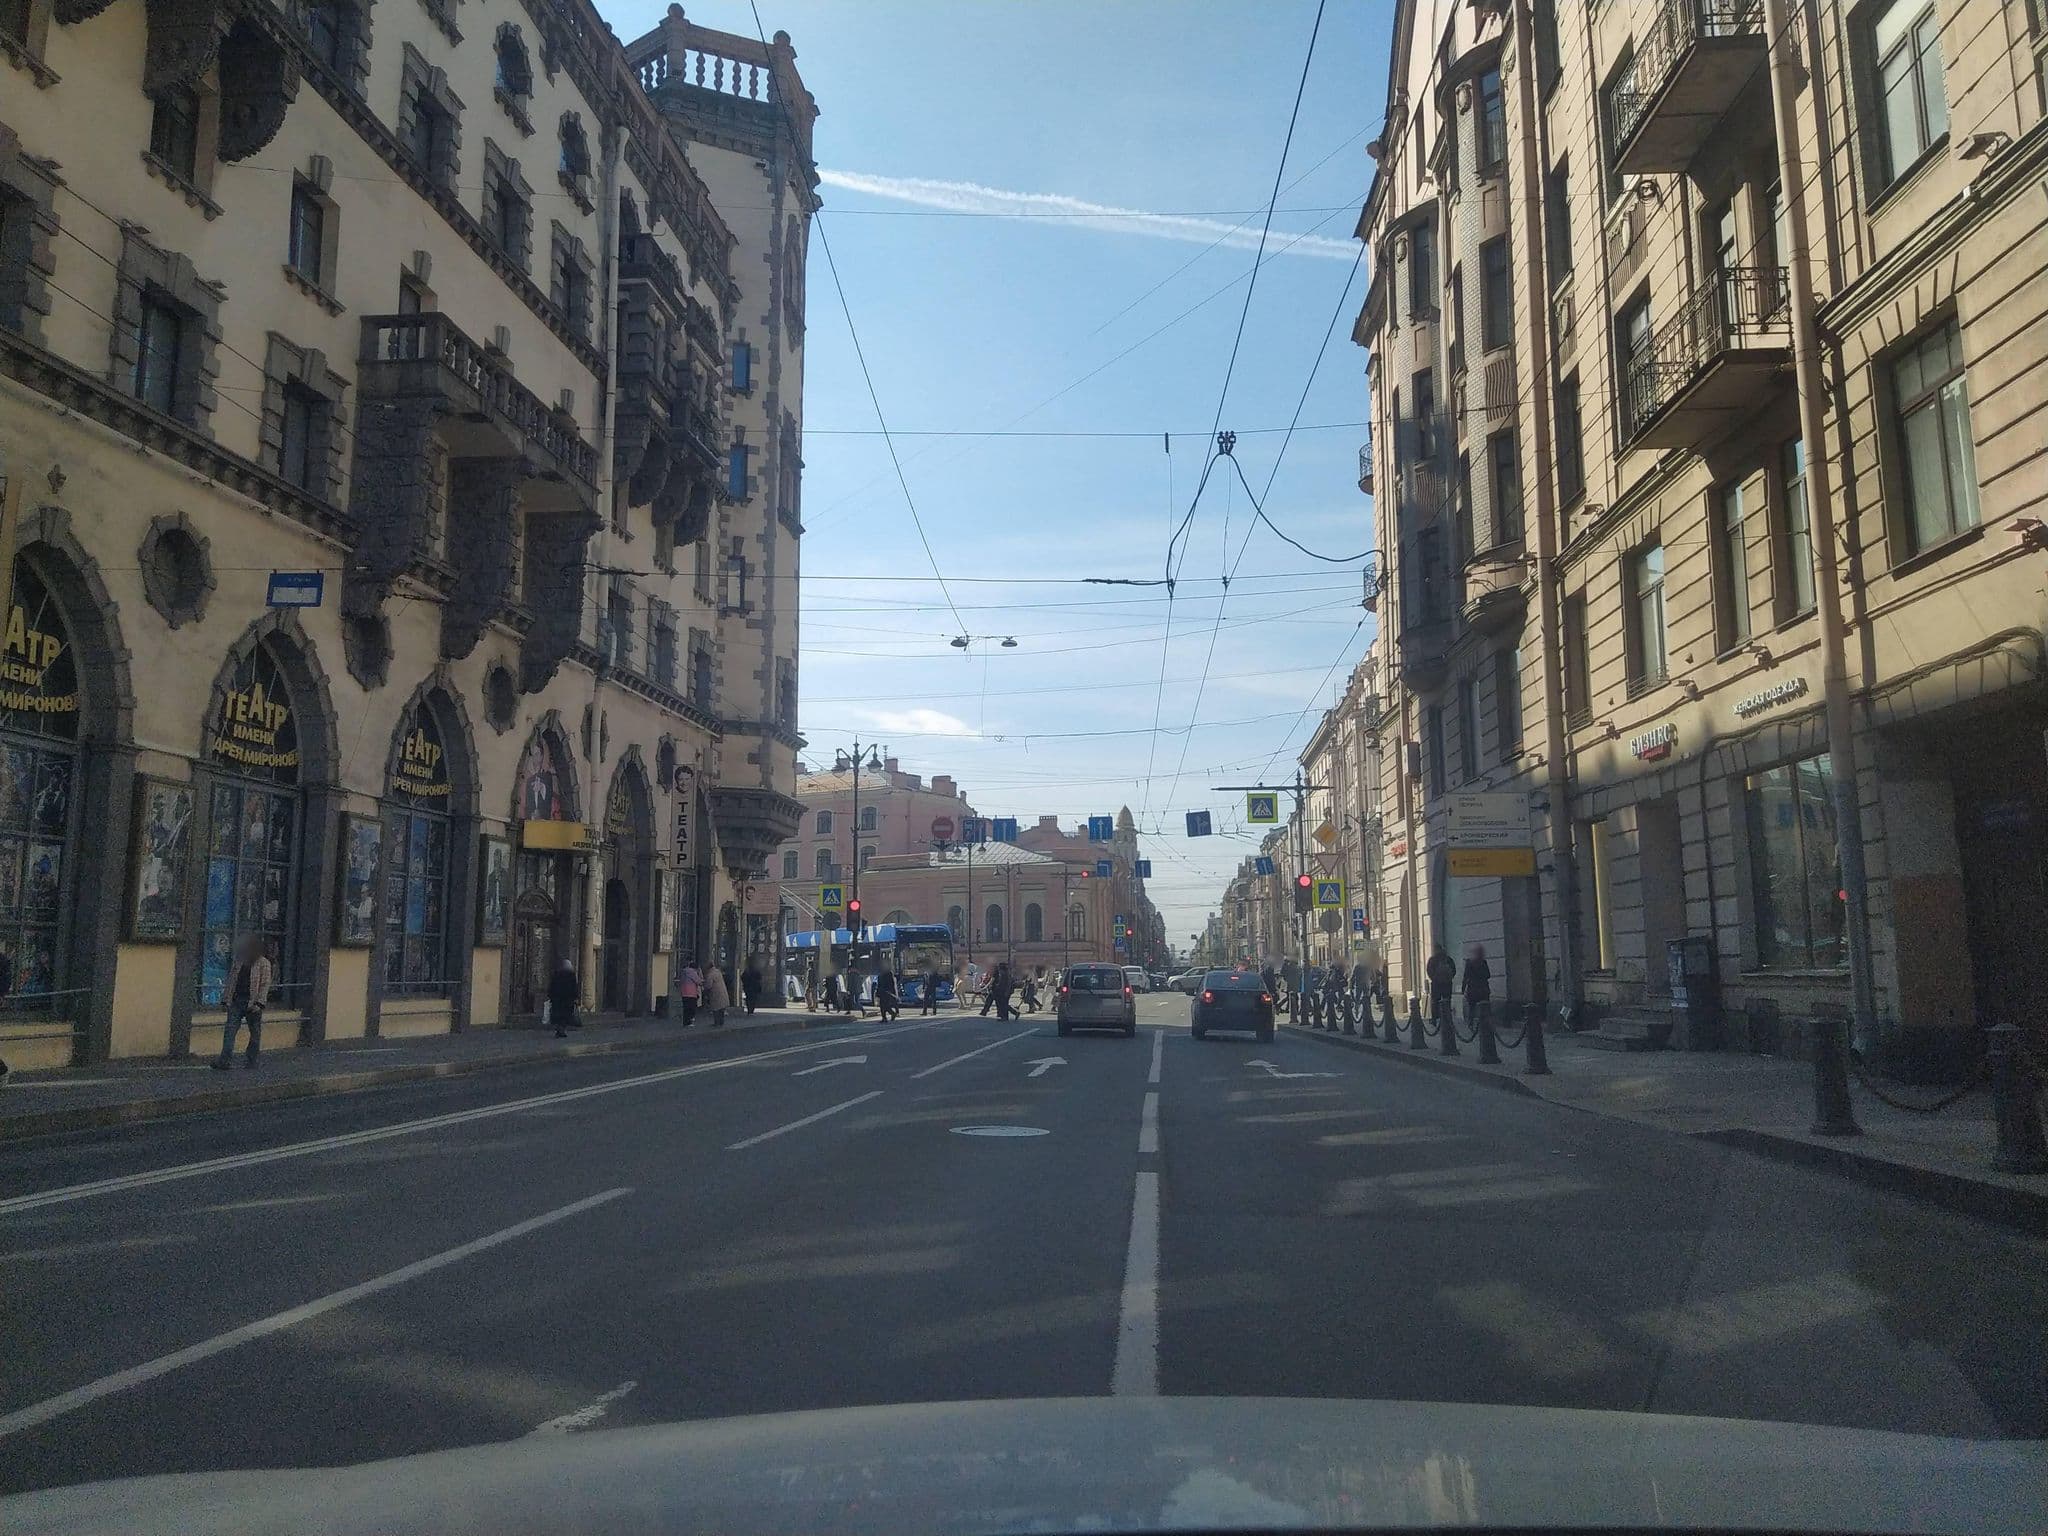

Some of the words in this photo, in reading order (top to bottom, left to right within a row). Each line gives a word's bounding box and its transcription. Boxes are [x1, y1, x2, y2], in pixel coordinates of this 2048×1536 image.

[3, 605, 61, 667] АТР
[0, 662, 42, 687] МЕНИ
[226, 683, 288, 730] ТЕАТР
[1733, 693, 1765, 713] ЖЕНСКАЯ
[1766, 678, 1800, 700] ОДЕЖДА
[234, 723, 275, 746] ИМЕНИ
[403, 762, 433, 779] ИМЕНИ
[676, 802, 688, 864] ТЕАТР
